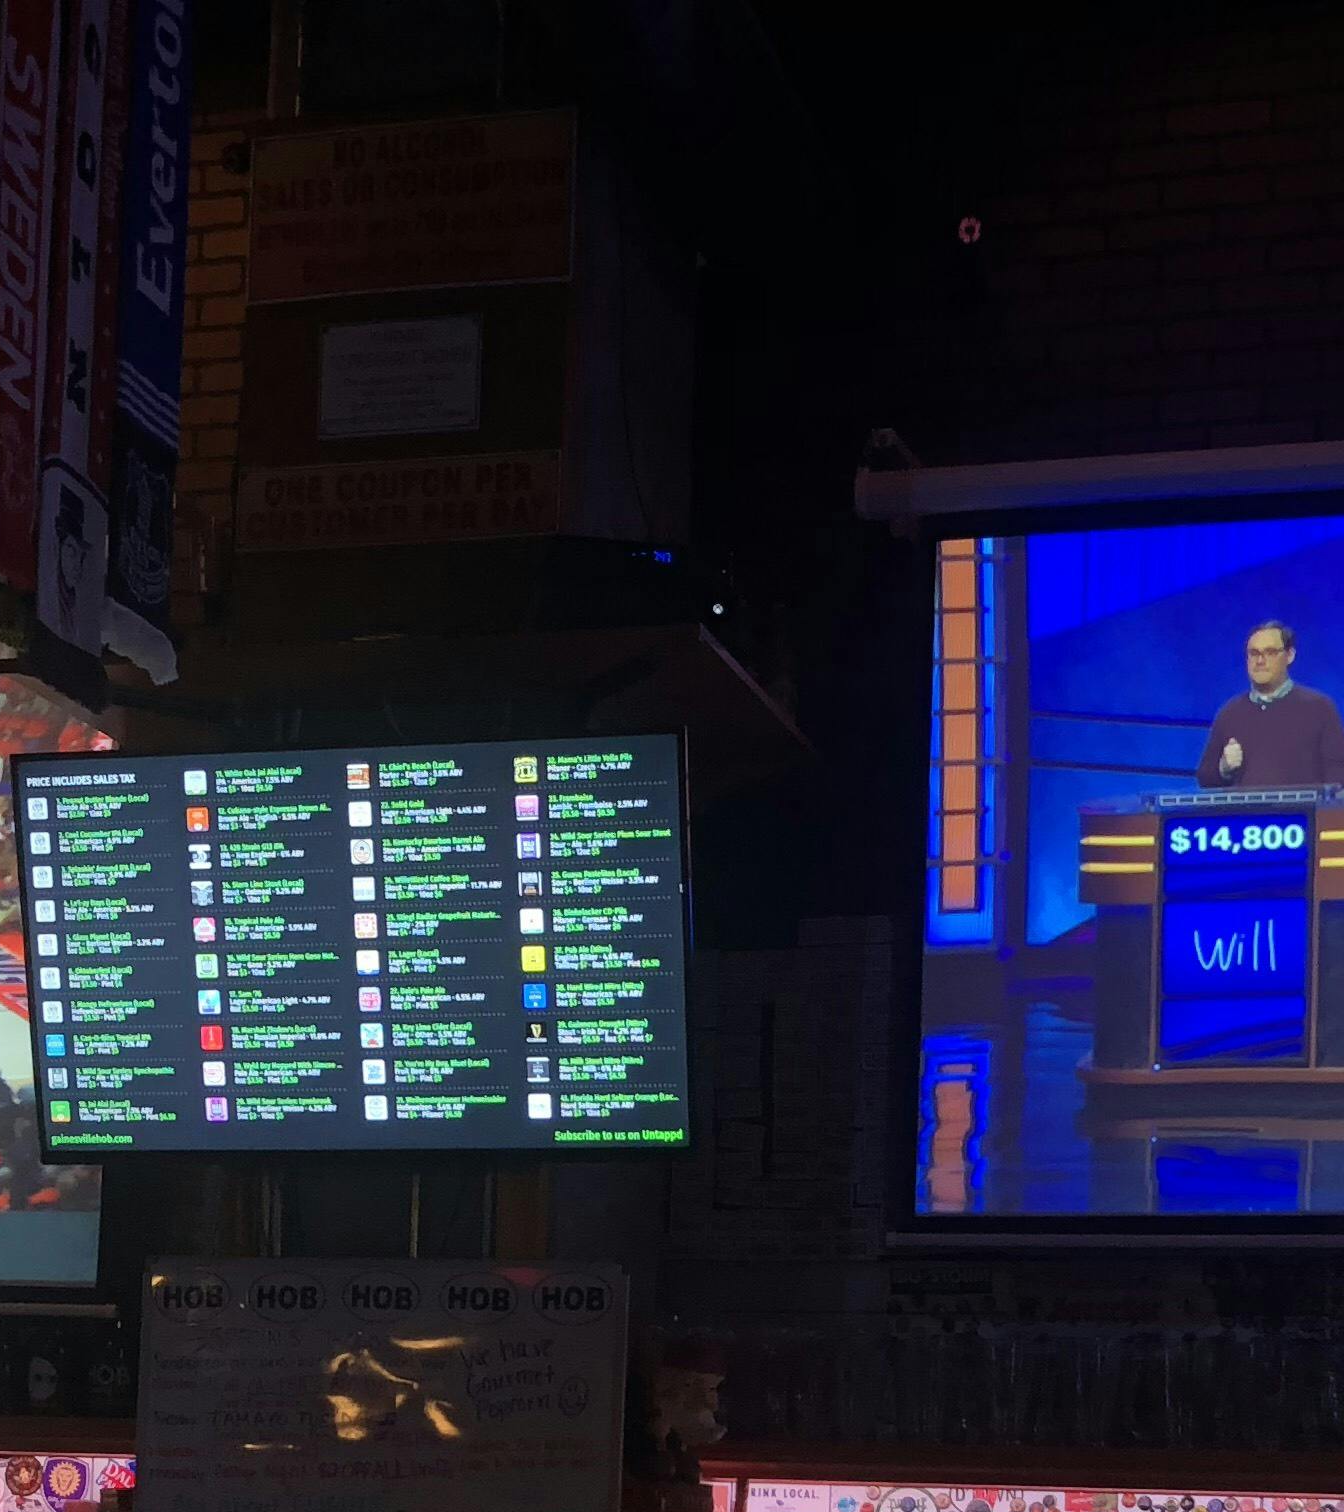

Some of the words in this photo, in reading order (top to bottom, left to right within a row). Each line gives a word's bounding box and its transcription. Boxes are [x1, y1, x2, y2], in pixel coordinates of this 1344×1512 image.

[264, 475, 326, 508] ONE
[335, 465, 463, 504] COUPON
[476, 462, 534, 493] PER
[26, 777, 52, 788] PRICE
[52, 775, 92, 787] INCLUDES
[93, 774, 118, 785] SALES
[119, 773, 136, 785] TAX
[1169, 823, 1305, 855] $14,800
[1193, 918, 1279, 974] Will
[51, 1132, 133, 1147] gainesvillehob.com
[554, 1130, 601, 1142] Subscribe
[602, 1131, 613, 1141] to
[614, 1131, 626, 1141] us
[627, 1131, 640, 1141] on
[642, 1128, 684, 1141] Untappd
[162, 1284, 225, 1309] HOB
[256, 1284, 318, 1310] HOB
[351, 1285, 414, 1311] HOB
[447, 1286, 511, 1312] HOB
[541, 1286, 606, 1312] HOB
[497, 1339, 554, 1362] have
